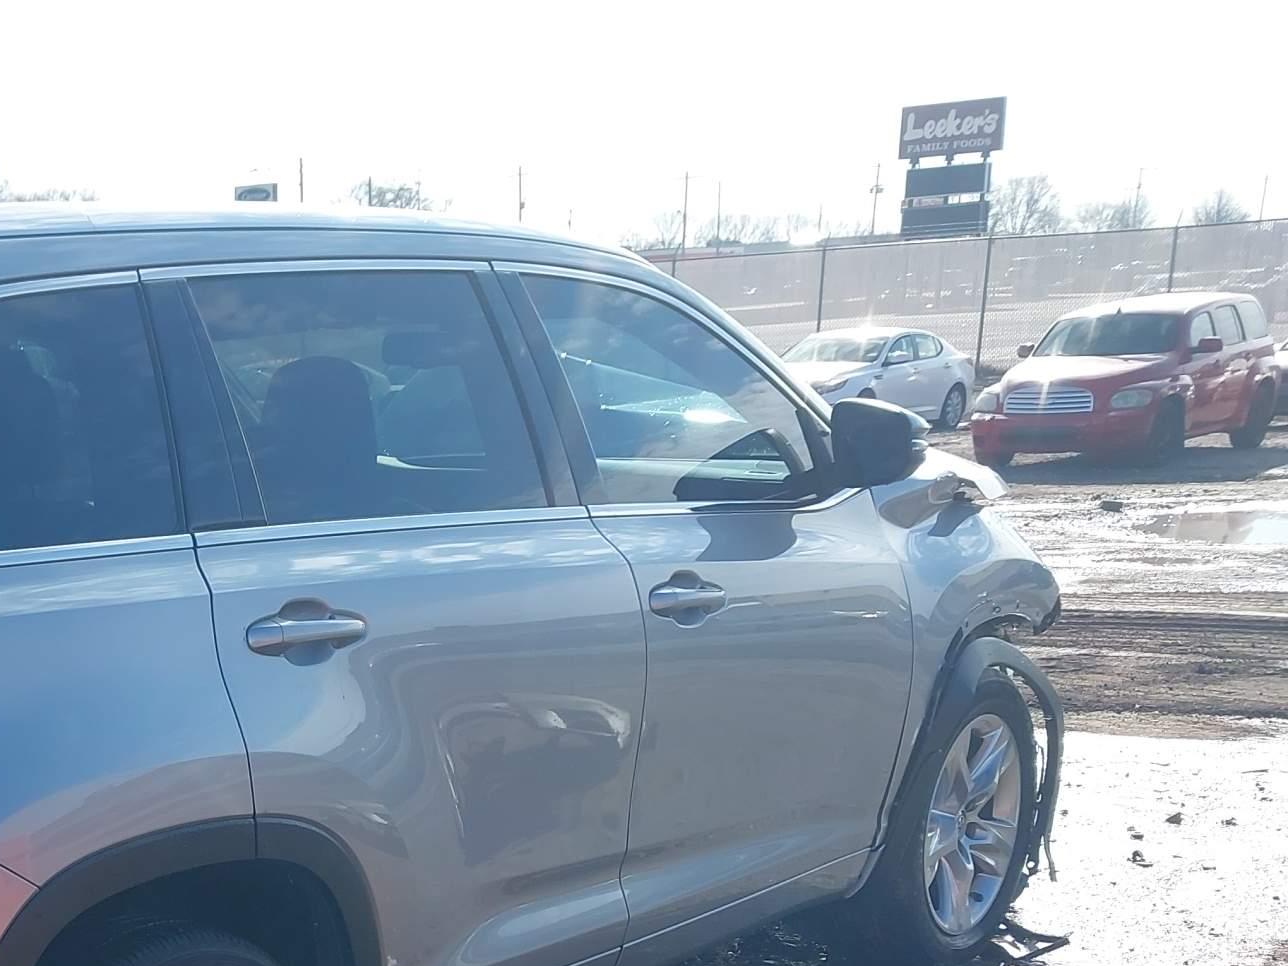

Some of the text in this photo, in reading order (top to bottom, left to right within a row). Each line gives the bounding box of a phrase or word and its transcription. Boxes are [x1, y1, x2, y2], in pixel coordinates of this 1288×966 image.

[903, 109, 1000, 141] Leeker's
[906, 137, 992, 153] FAMILY FOODS
